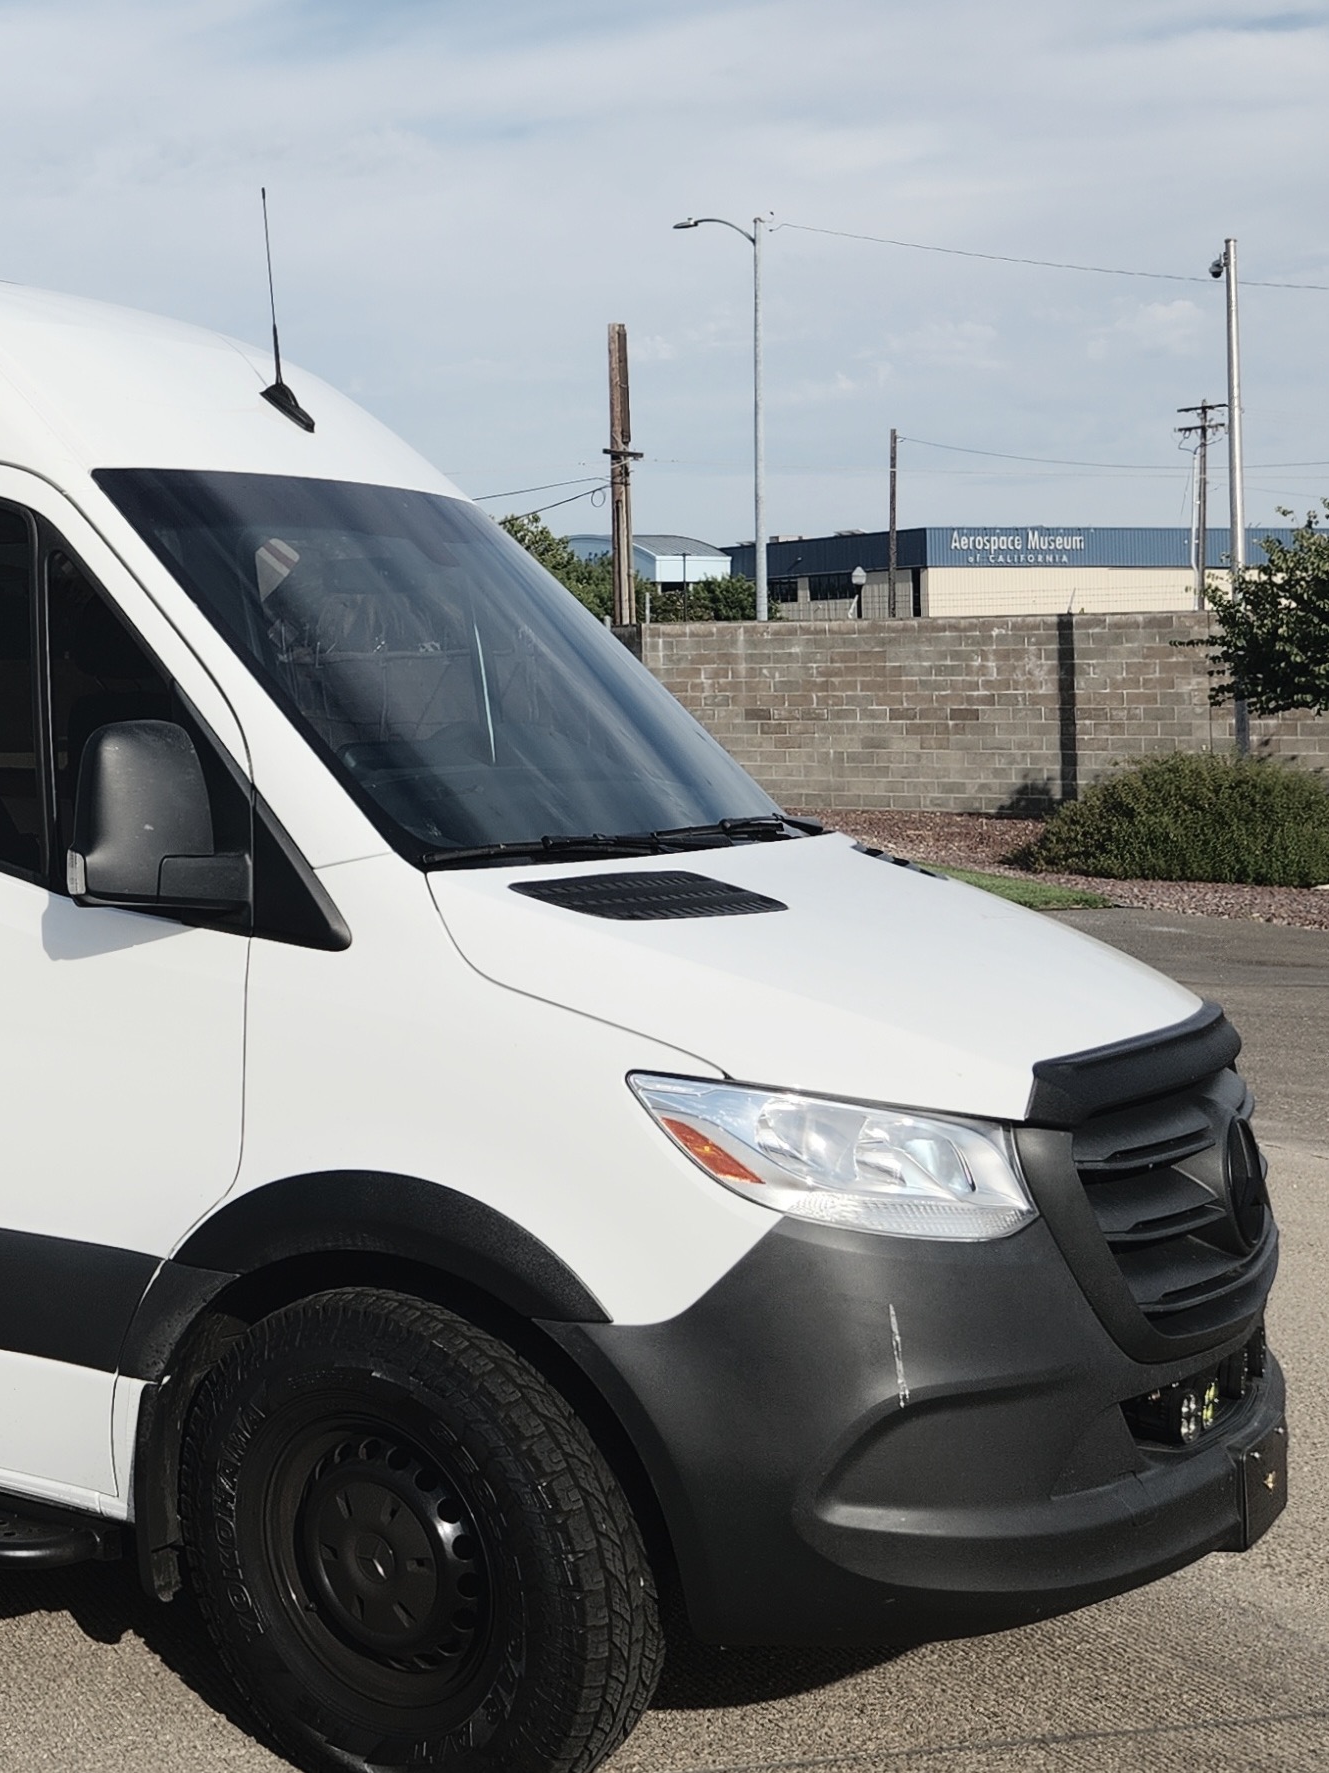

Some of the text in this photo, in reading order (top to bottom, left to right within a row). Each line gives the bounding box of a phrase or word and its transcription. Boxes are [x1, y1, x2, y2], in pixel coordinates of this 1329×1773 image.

[951, 530, 1084, 554] Aerospace Museum
[968, 553, 1068, 563] of CALIFORNIA
[213, 1402, 268, 1643] YOKOHAMA
